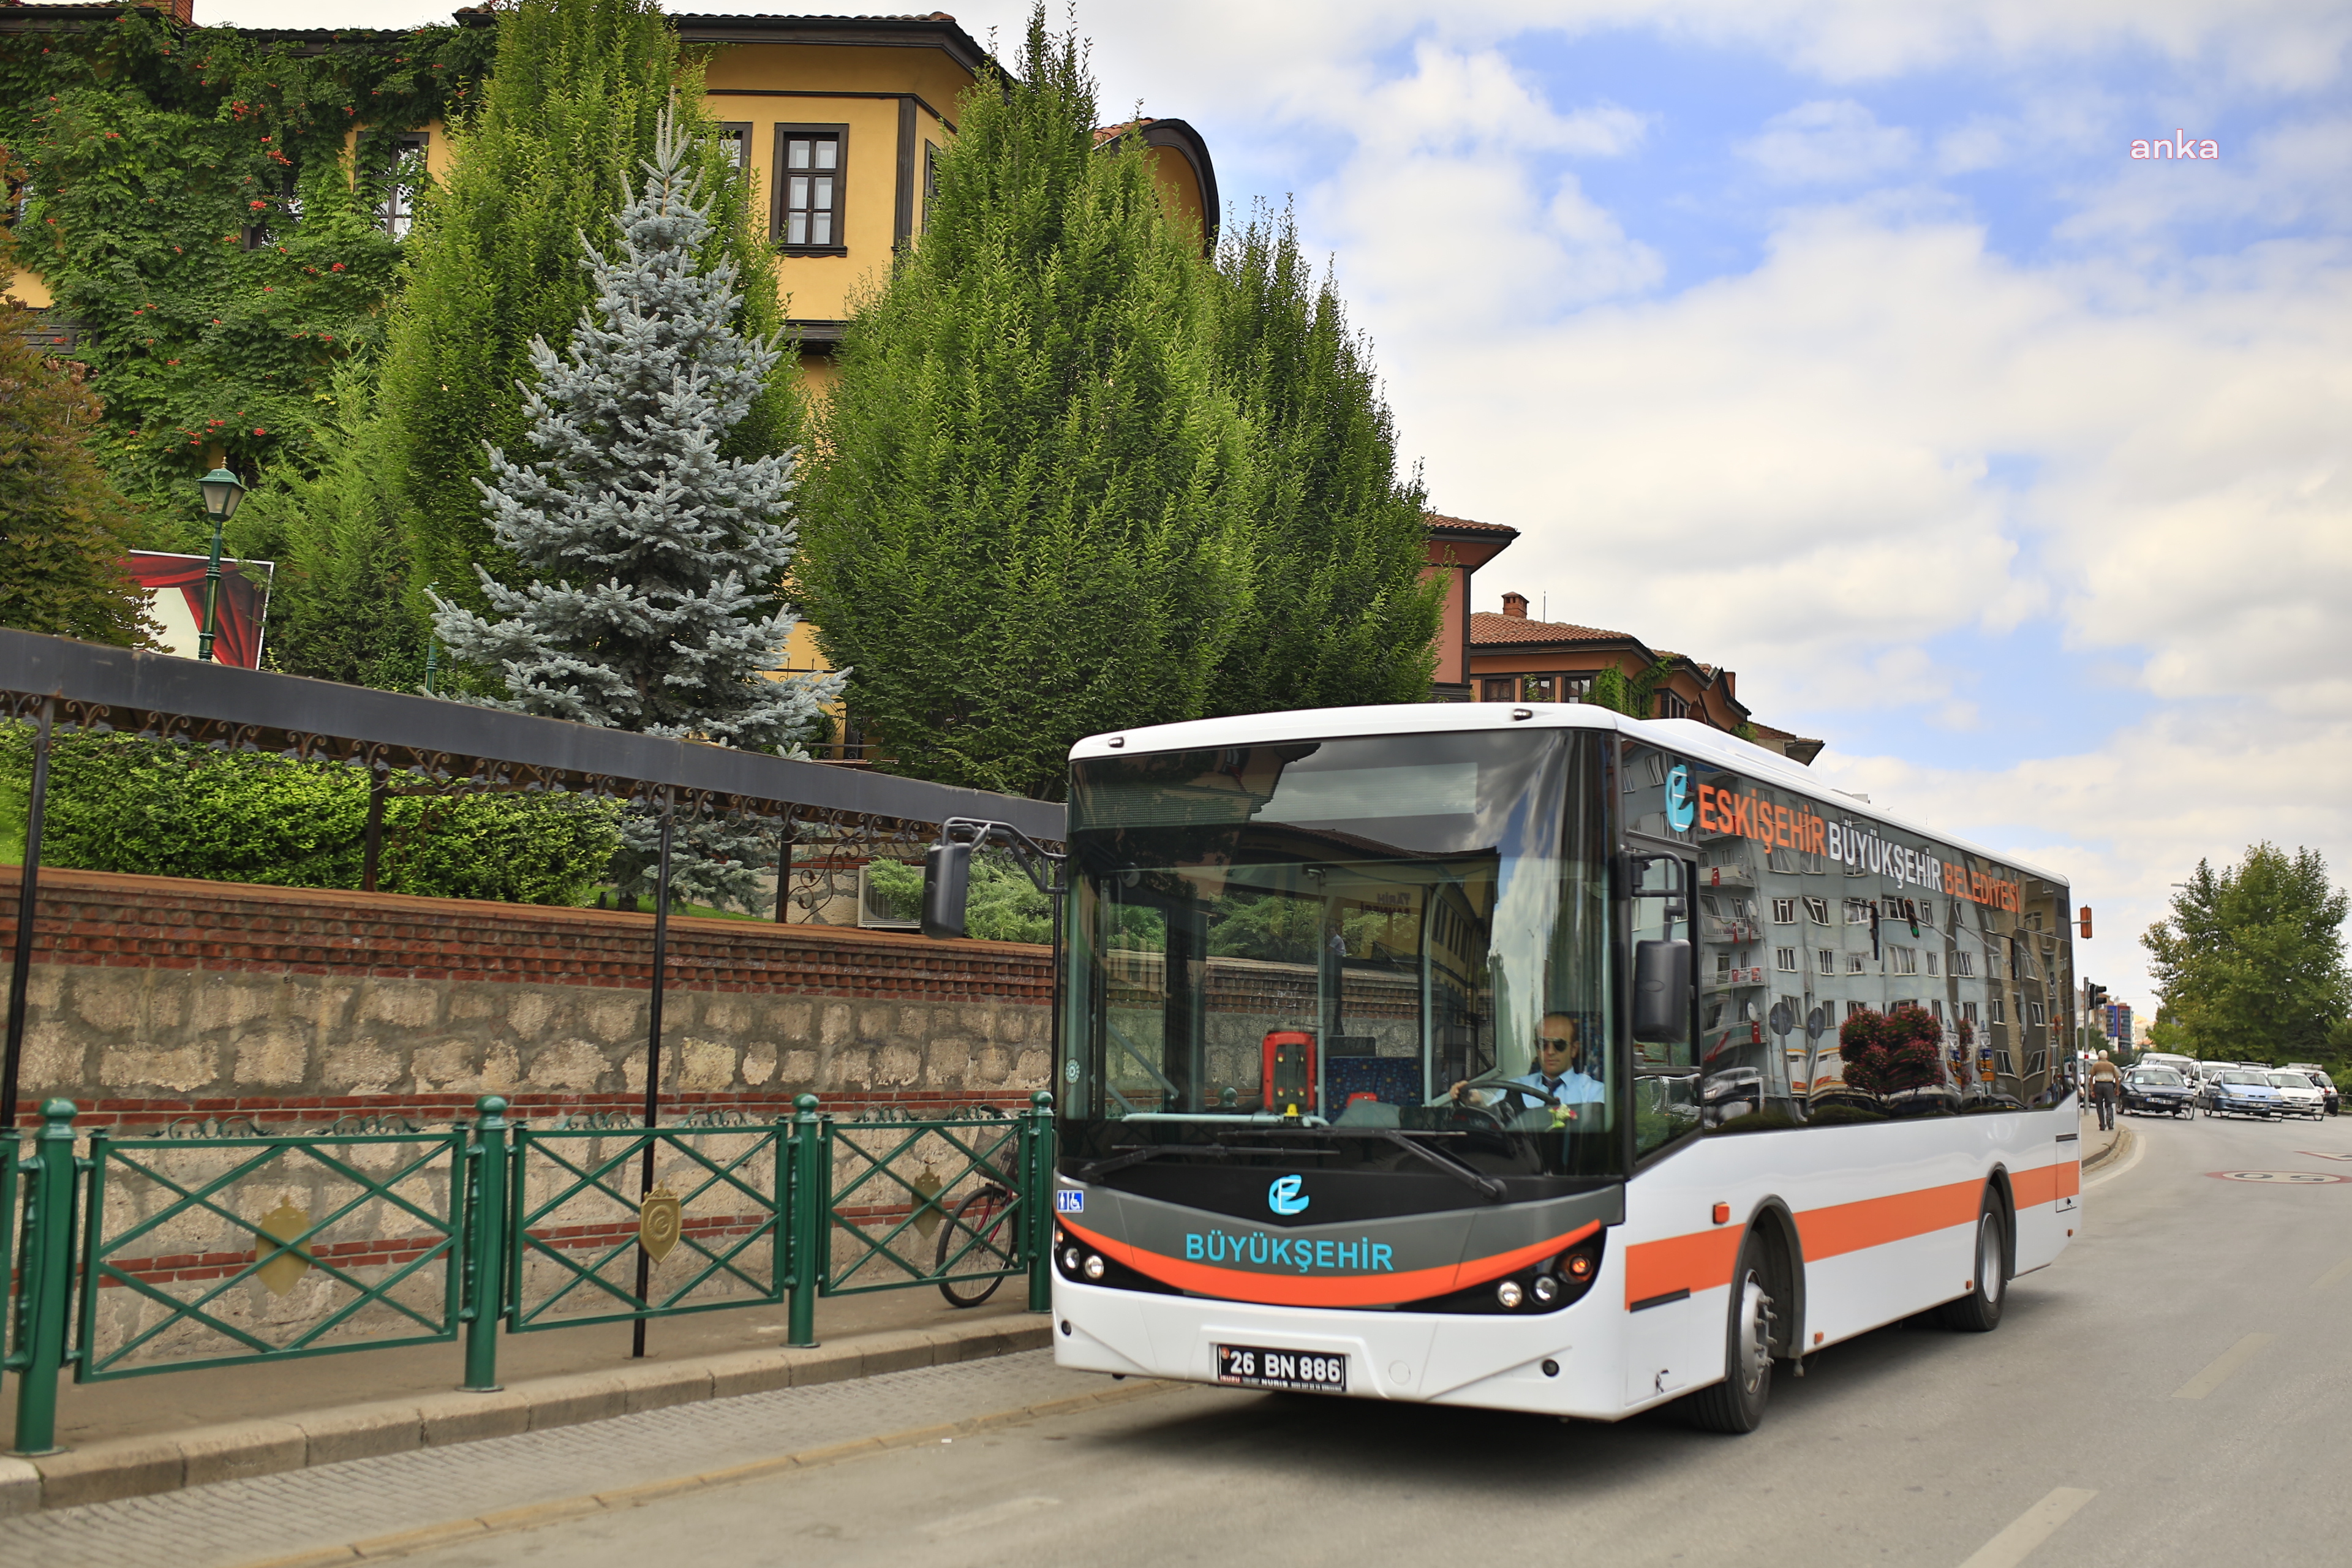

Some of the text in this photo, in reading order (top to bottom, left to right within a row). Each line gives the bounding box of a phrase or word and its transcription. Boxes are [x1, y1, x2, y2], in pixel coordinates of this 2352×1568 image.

[1698, 783, 2020, 913] ESKİŞEHİR BÜYÜKŞEHİR BELEDİYESİ
[1186, 1229, 1393, 1273] BÜYÜKŞEHİR
[1230, 1350, 1340, 1382] 26 BN 886
